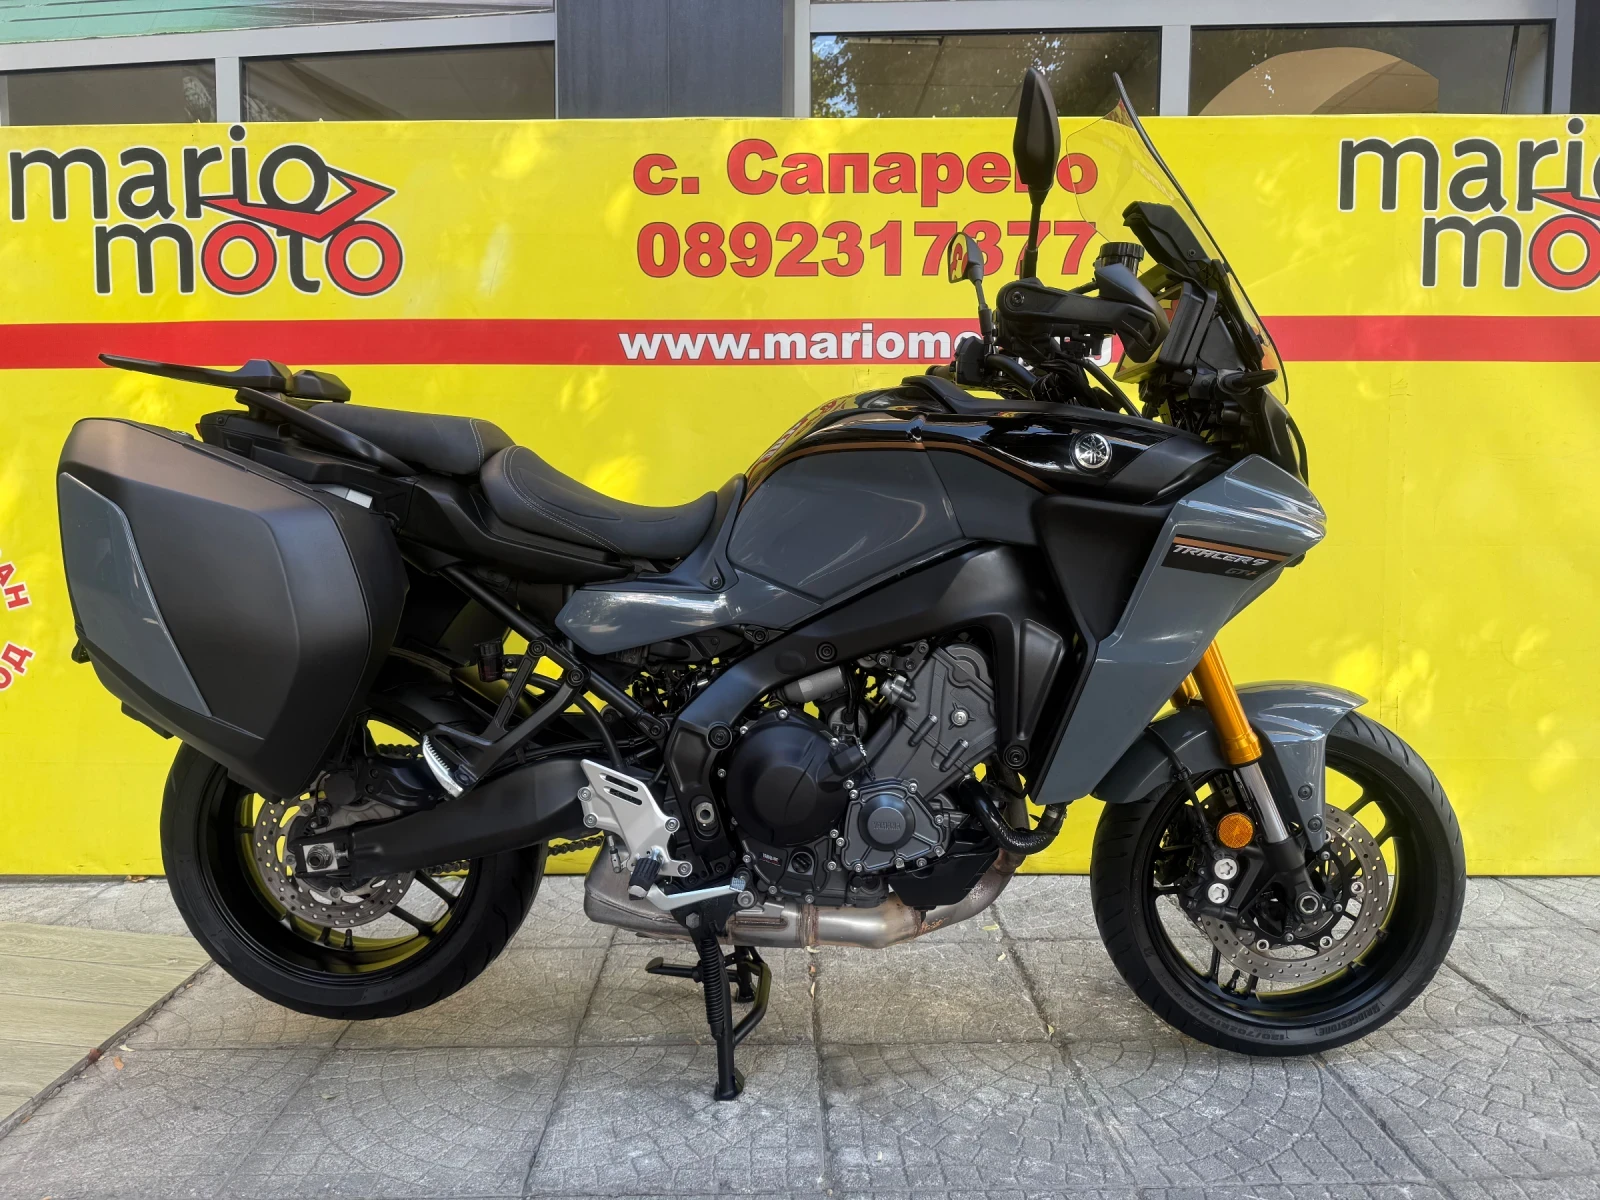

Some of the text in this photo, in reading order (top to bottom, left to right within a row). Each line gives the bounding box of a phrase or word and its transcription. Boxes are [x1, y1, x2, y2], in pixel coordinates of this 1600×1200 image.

[9, 124, 329, 220] mario
[632, 152, 700, 195] с.
[727, 138, 1098, 207] Сапарео
[1338, 117, 1600, 212] mari
[95, 220, 403, 296] moto
[636, 220, 1096, 278] 0892317377
[1318, 1002, 1382, 1037] BRIDGESTONE
